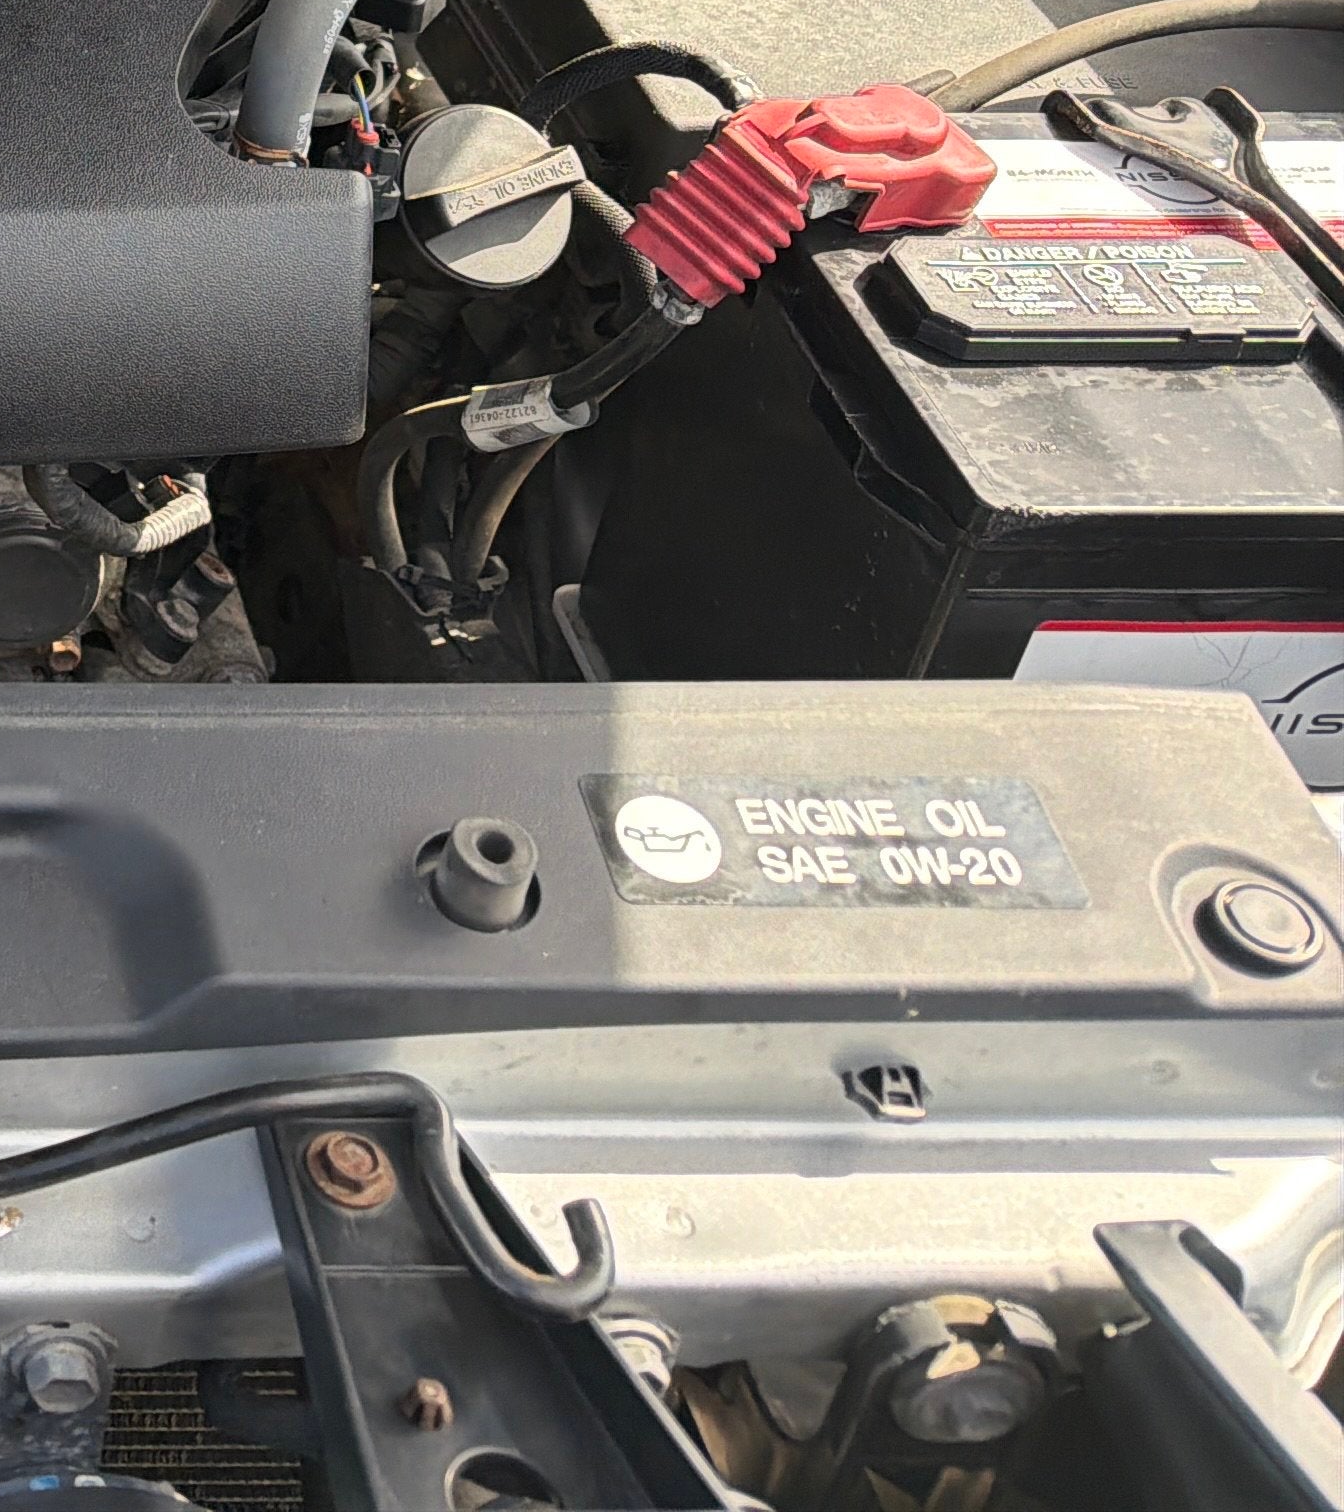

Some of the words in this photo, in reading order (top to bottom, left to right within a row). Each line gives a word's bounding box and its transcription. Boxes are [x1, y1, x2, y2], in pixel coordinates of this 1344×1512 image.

[1076, 75, 1139, 89] FUSE
[521, 159, 576, 190] ENGINE
[488, 182, 516, 200] OIL
[981, 246, 1084, 261] DANGER
[1101, 244, 1195, 259] POISON
[735, 799, 907, 837] ENGINE
[925, 799, 1007, 838] OIL
[756, 846, 857, 884] SAE
[878, 846, 1023, 887] 0W-20
